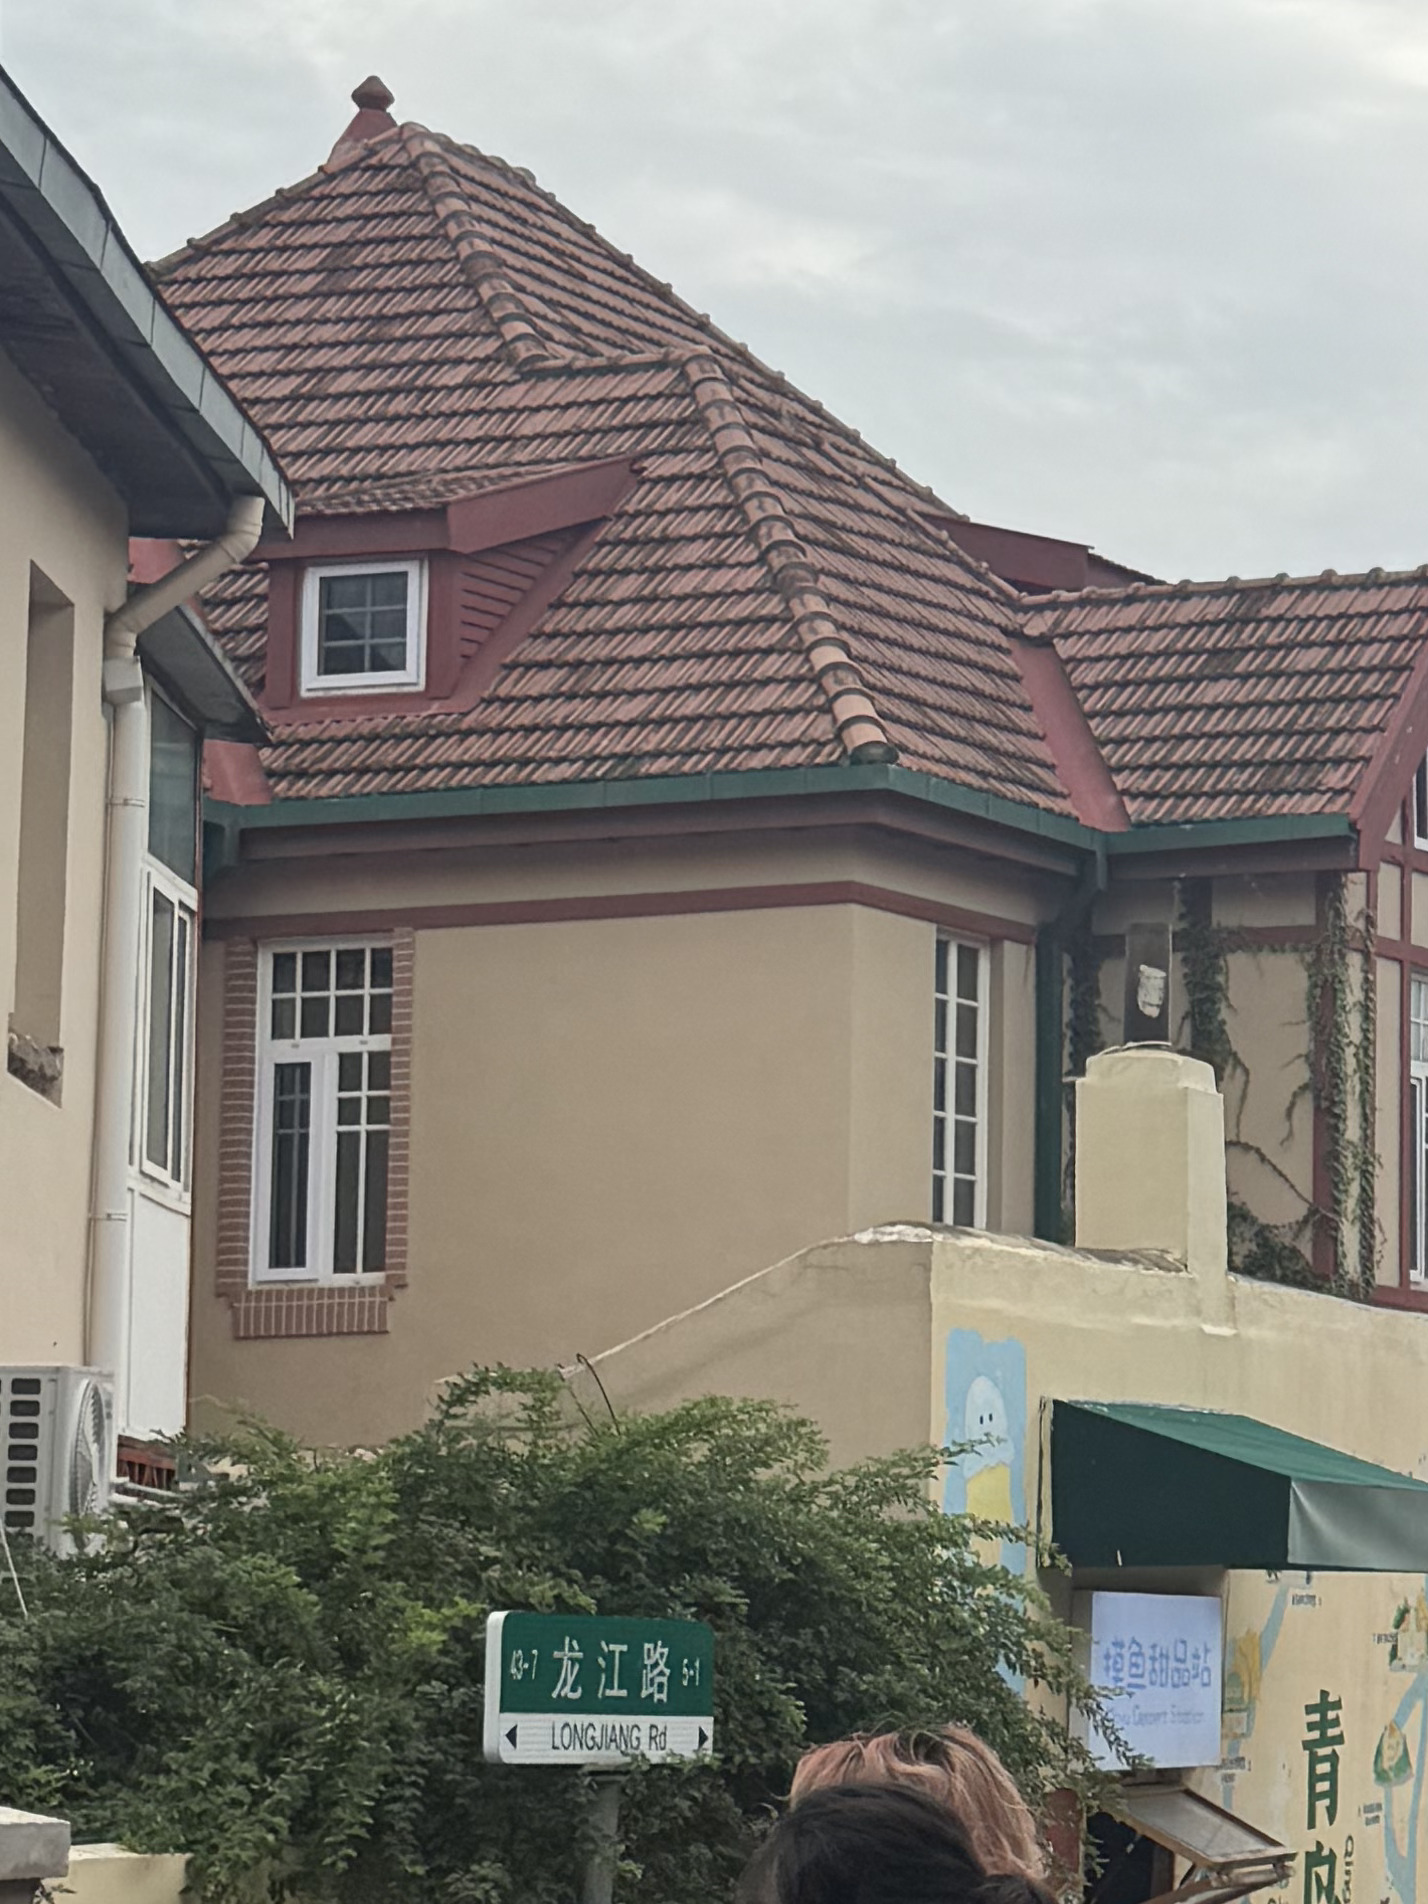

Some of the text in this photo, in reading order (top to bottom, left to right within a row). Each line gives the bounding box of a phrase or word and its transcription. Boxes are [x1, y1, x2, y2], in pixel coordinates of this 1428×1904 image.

[551, 1636, 671, 1703] 龙江路
[1103, 1636, 1212, 1690] 摸鱼甜品站
[552, 1722, 668, 1751] LONGJIANG Rd
